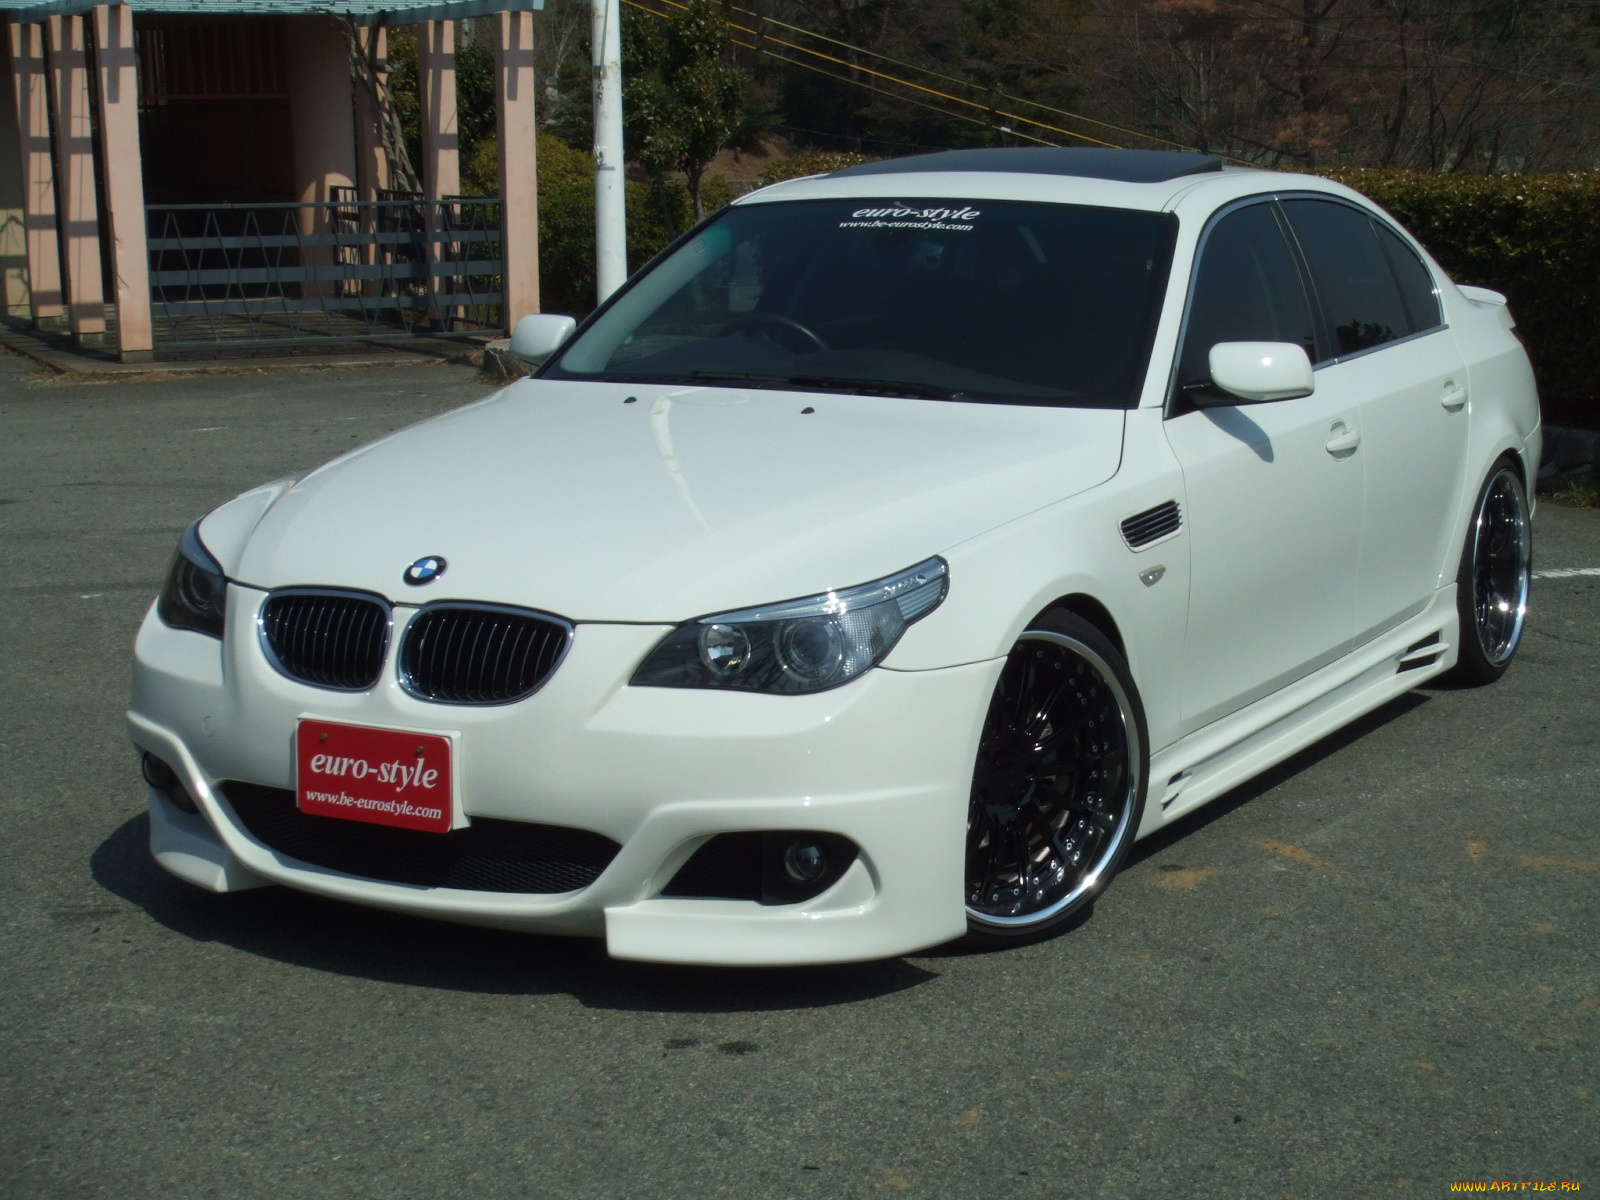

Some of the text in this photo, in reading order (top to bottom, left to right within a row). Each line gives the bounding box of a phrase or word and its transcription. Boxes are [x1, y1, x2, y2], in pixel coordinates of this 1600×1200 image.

[852, 207, 980, 221] euro-style
[839, 220, 973, 231] www.be-eurostyle.com
[310, 753, 438, 792] euro-style
[306, 791, 442, 819] www.be-eurostyle.com
